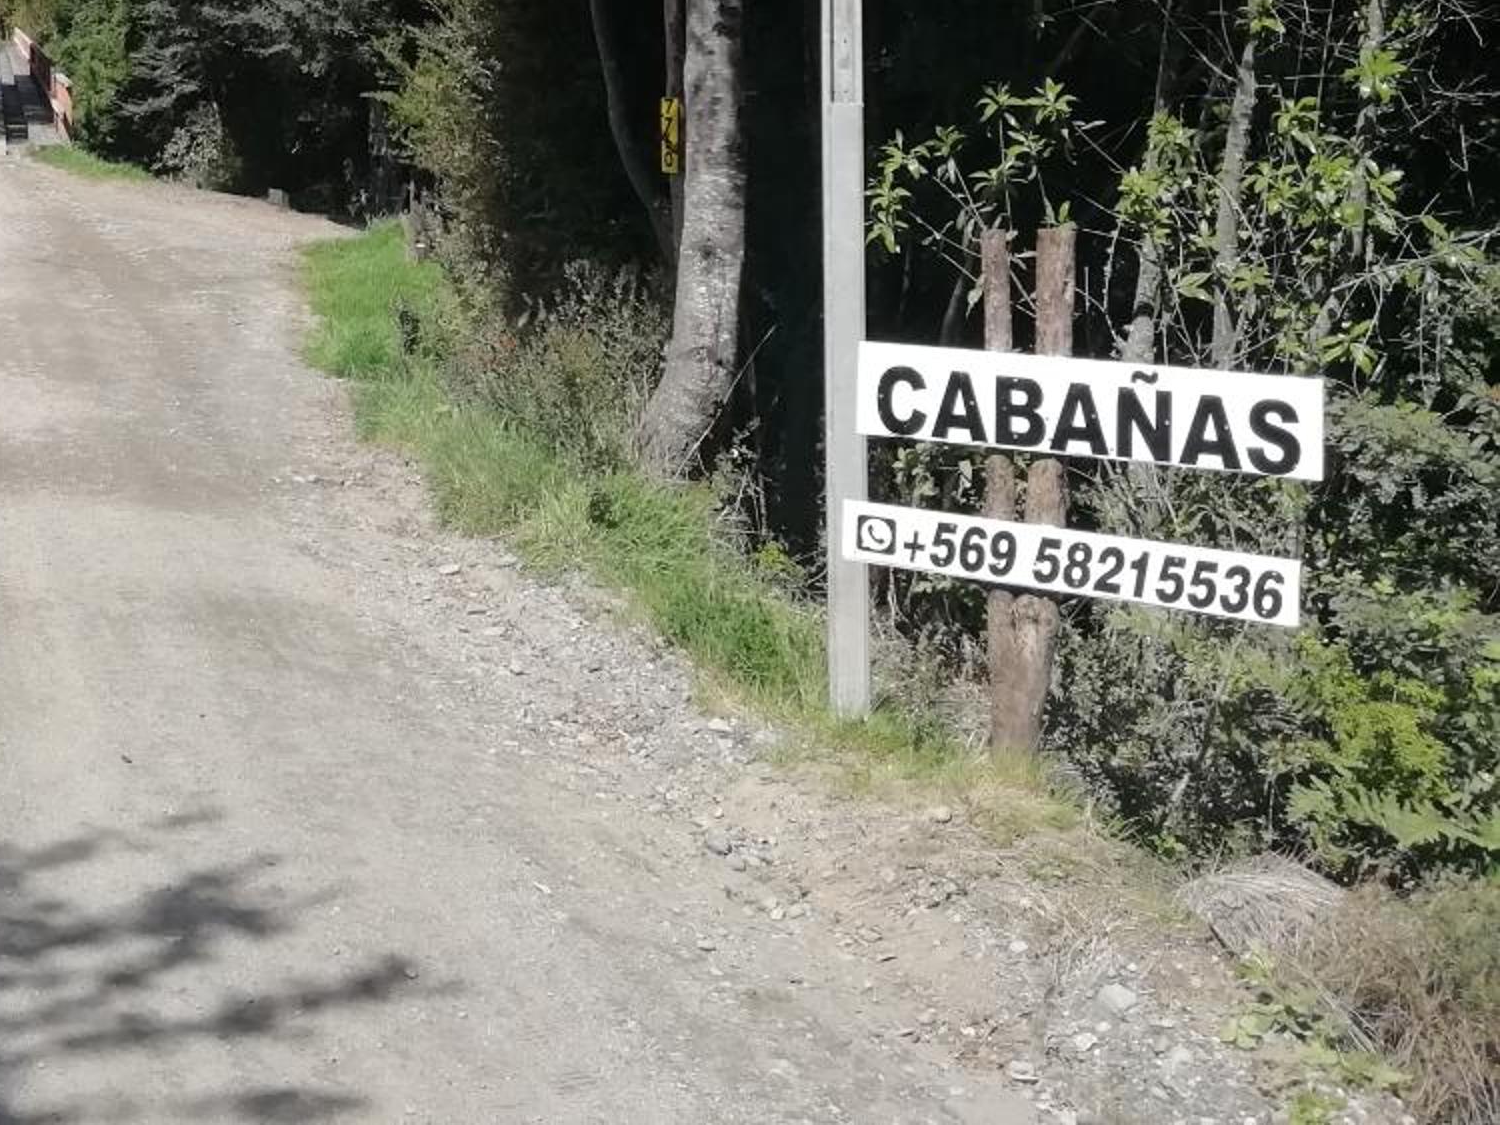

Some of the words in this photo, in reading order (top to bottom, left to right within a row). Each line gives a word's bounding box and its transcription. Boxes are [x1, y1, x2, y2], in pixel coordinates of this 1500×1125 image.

[877, 365, 1301, 475] CABAÑAS
[903, 522, 1018, 576] +569
[1032, 537, 1286, 619] 58215536
